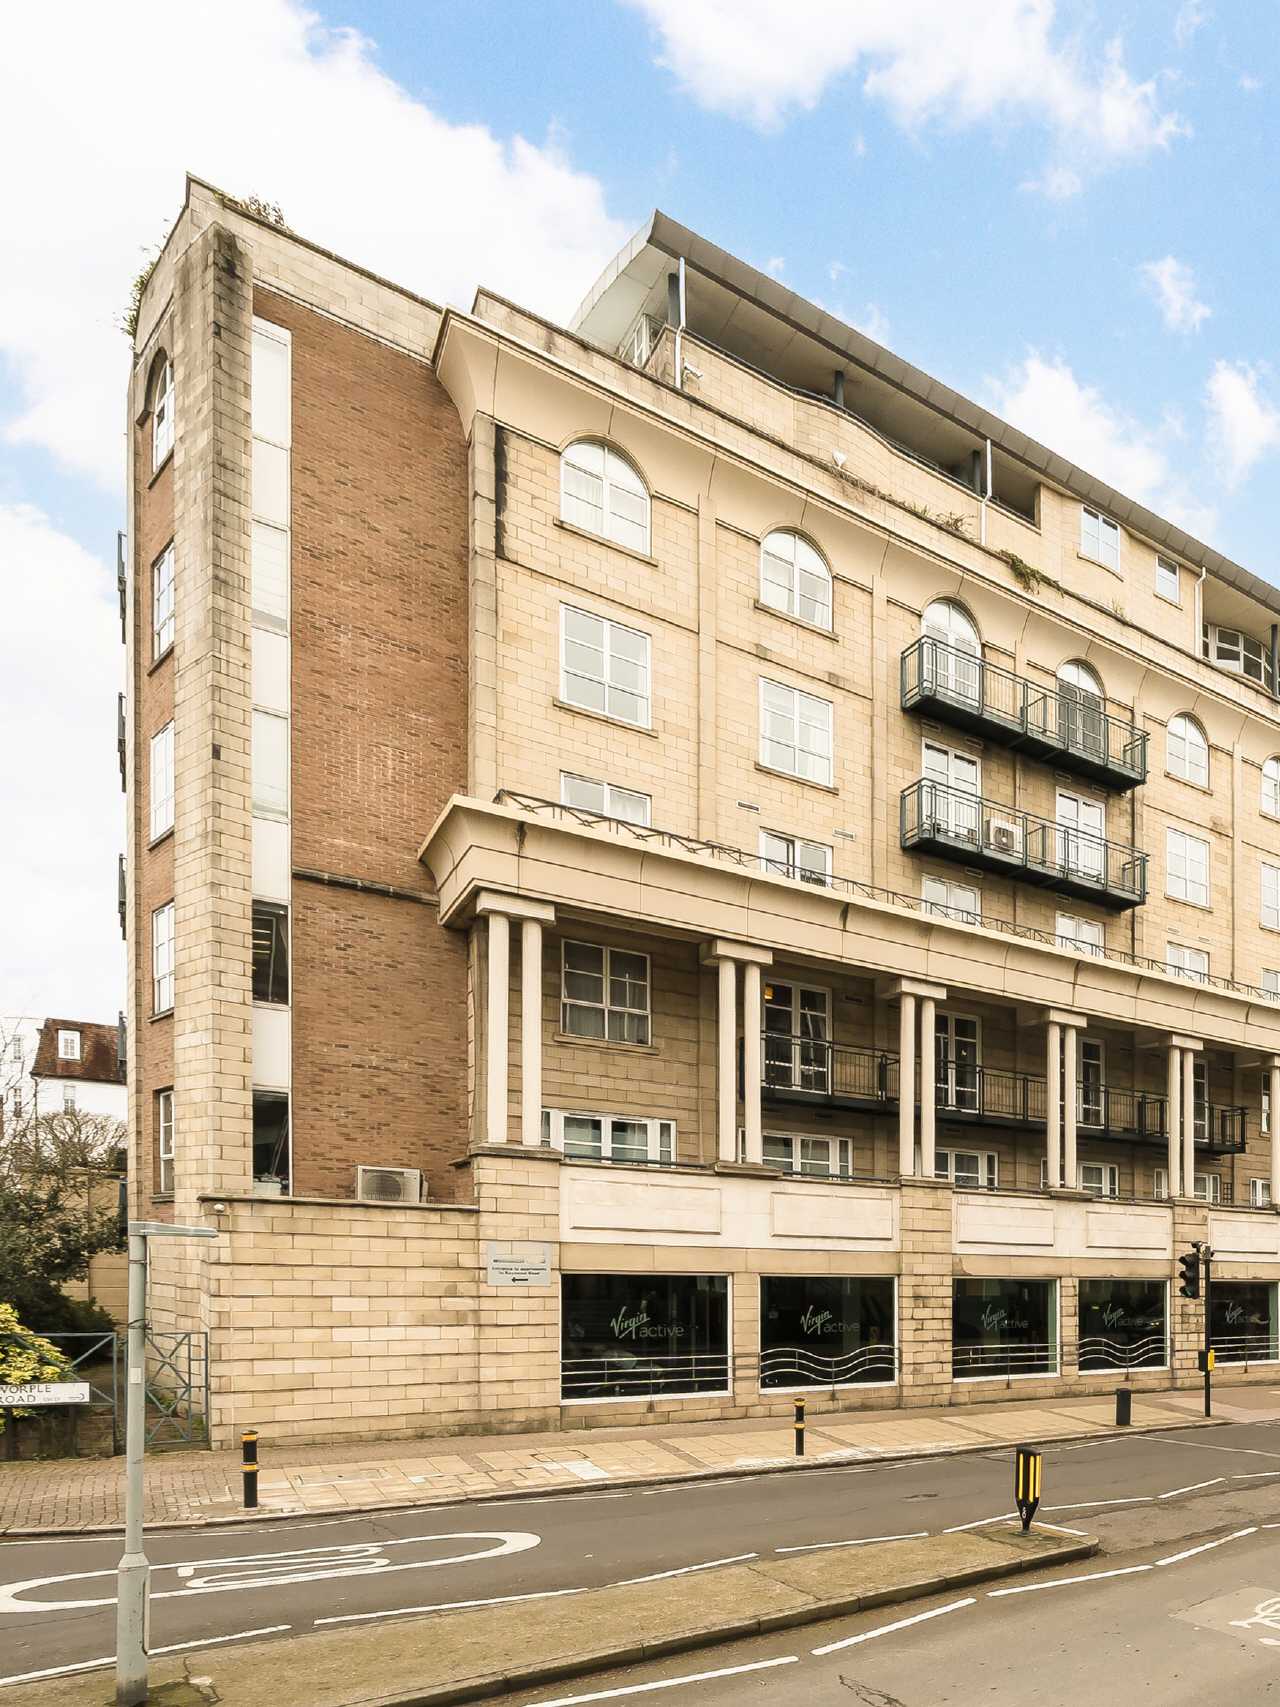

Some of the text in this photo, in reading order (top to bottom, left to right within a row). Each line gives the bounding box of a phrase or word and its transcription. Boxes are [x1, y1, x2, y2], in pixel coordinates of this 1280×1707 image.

[610, 1306, 685, 1340] Virgin active
[800, 1305, 860, 1335] Virgin active
